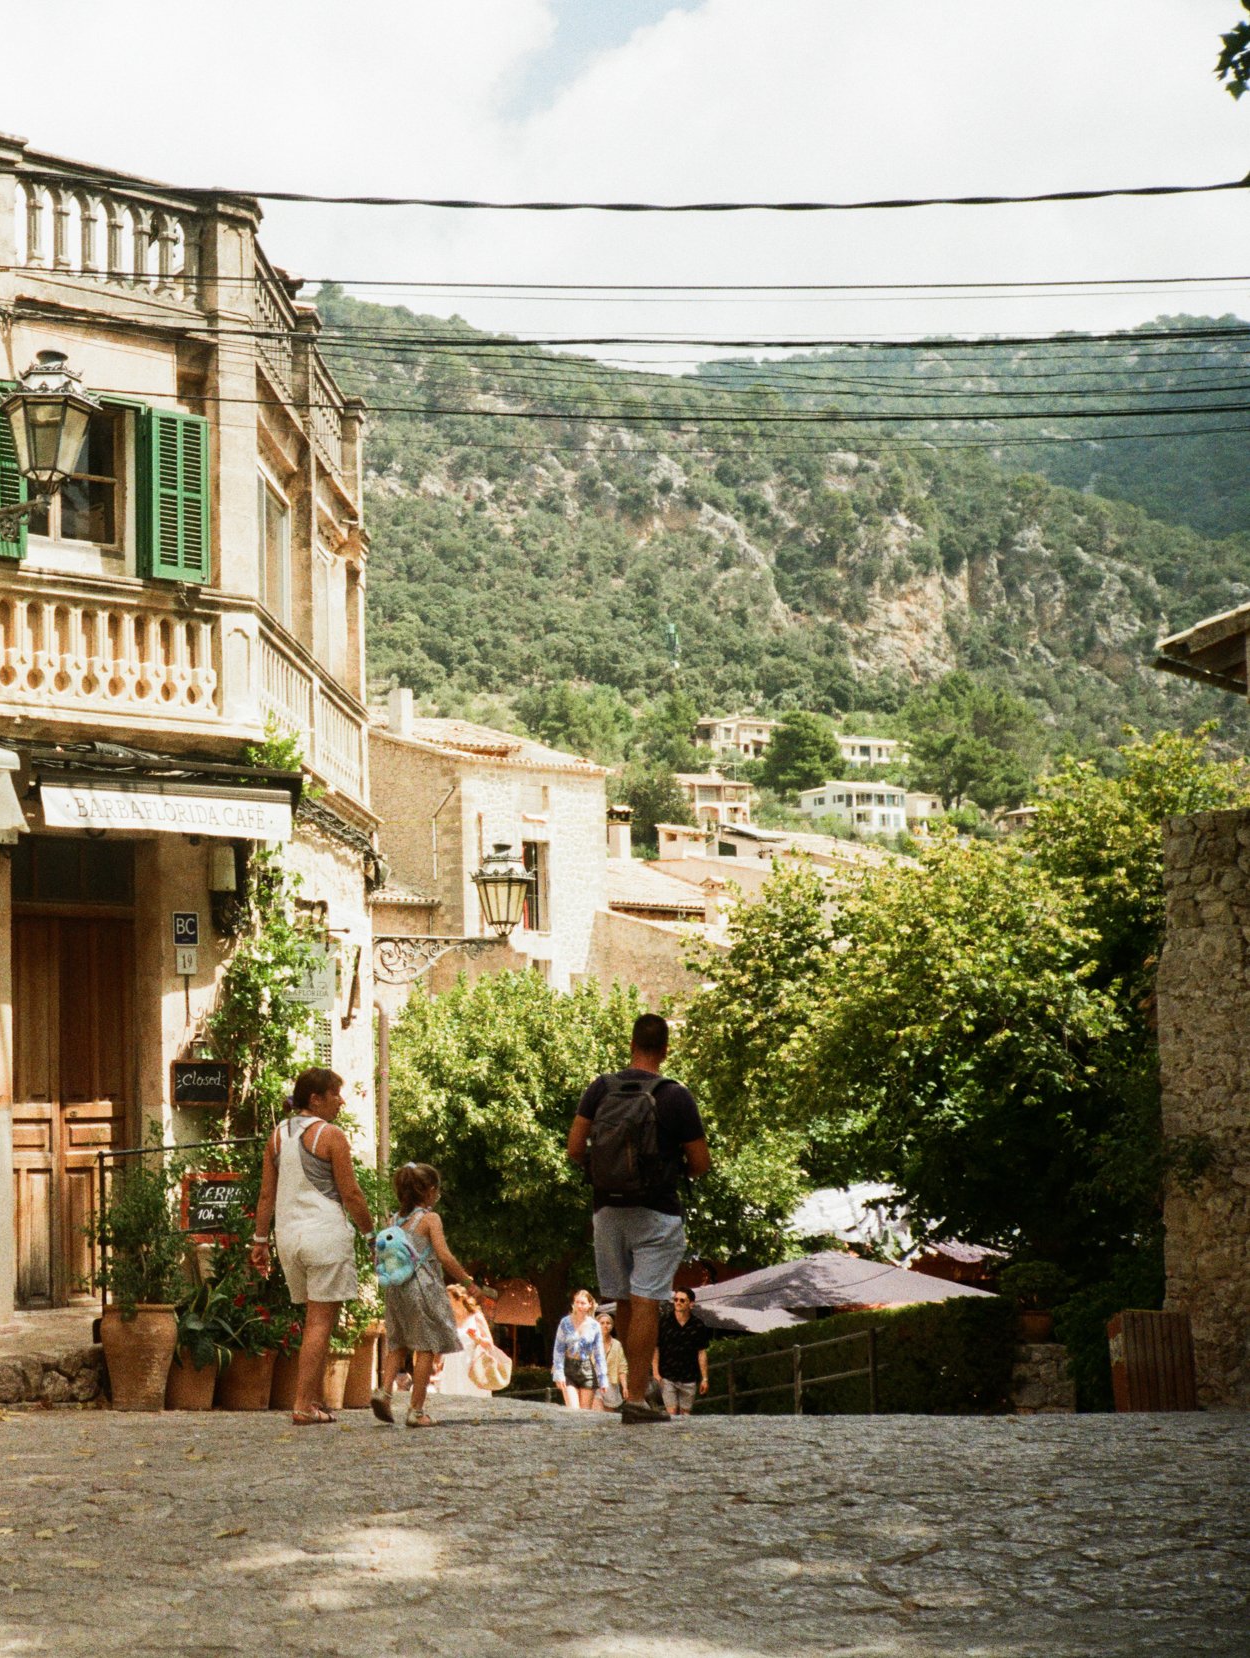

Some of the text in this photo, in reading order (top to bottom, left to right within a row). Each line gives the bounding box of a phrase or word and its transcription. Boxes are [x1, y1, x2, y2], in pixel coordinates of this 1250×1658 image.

[74, 796, 220, 826] BARBAFLORIDA
[176, 917, 196, 935] BC
[182, 953, 193, 969] 19
[182, 1070, 222, 1087] Closed
[197, 1208, 215, 1220] 10h
